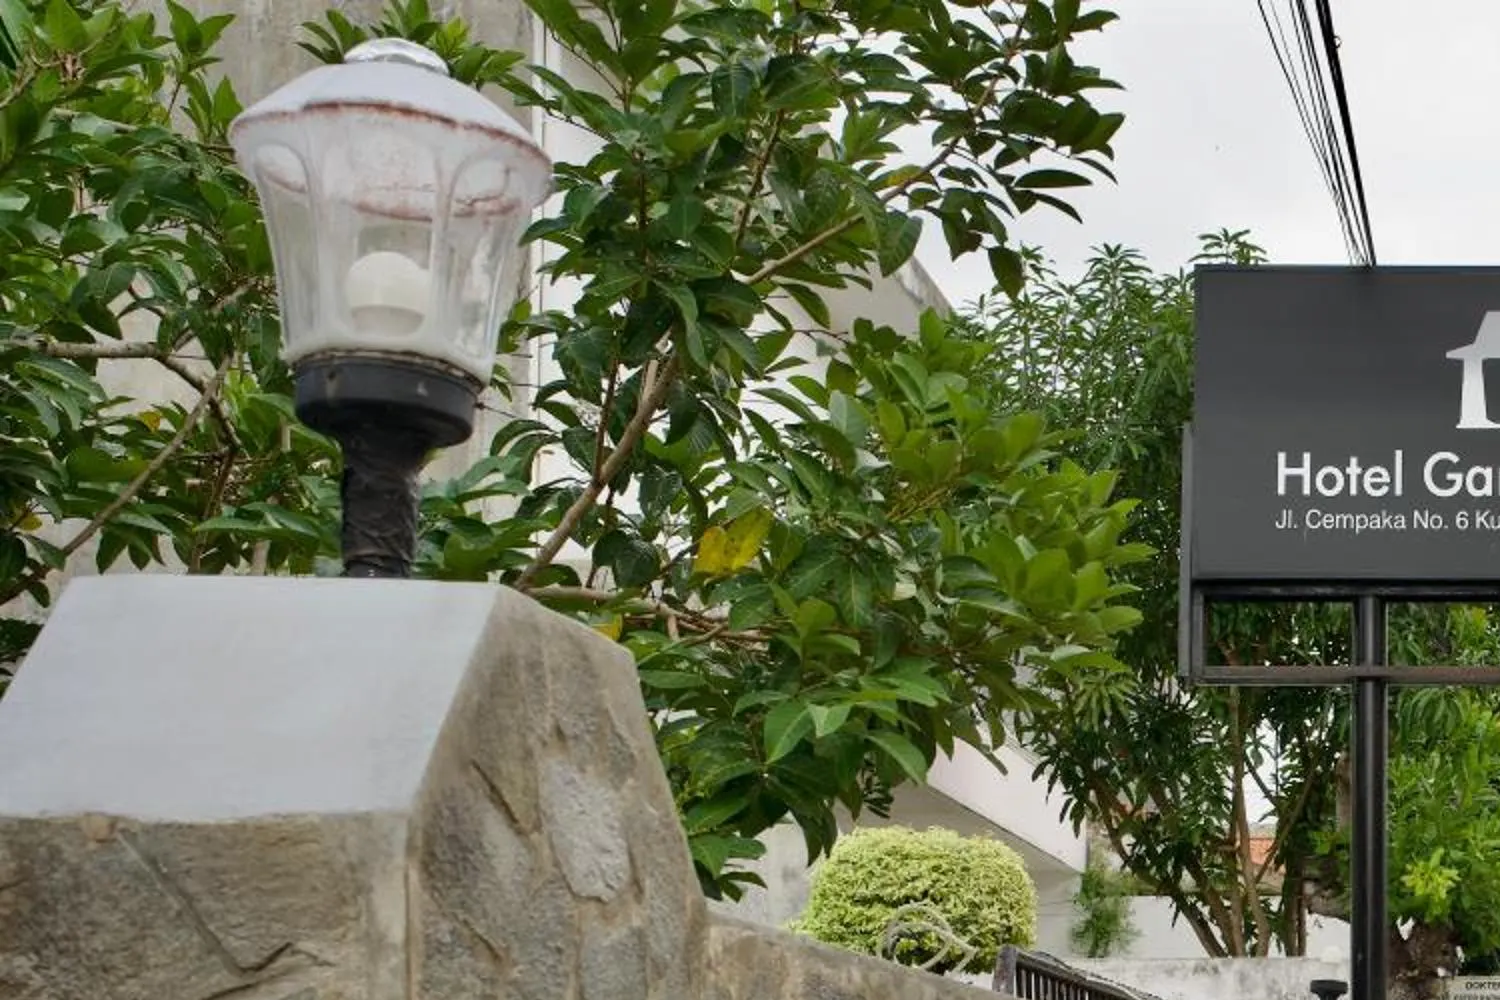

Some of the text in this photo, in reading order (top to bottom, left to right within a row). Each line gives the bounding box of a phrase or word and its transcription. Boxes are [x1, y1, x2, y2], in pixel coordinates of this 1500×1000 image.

[1276, 449, 1403, 497] Hotel
[1275, 509, 1298, 530] Jl.
[1305, 508, 1407, 534] Cempaka
[1413, 509, 1449, 530] No.
[1455, 510, 1469, 530] 6
